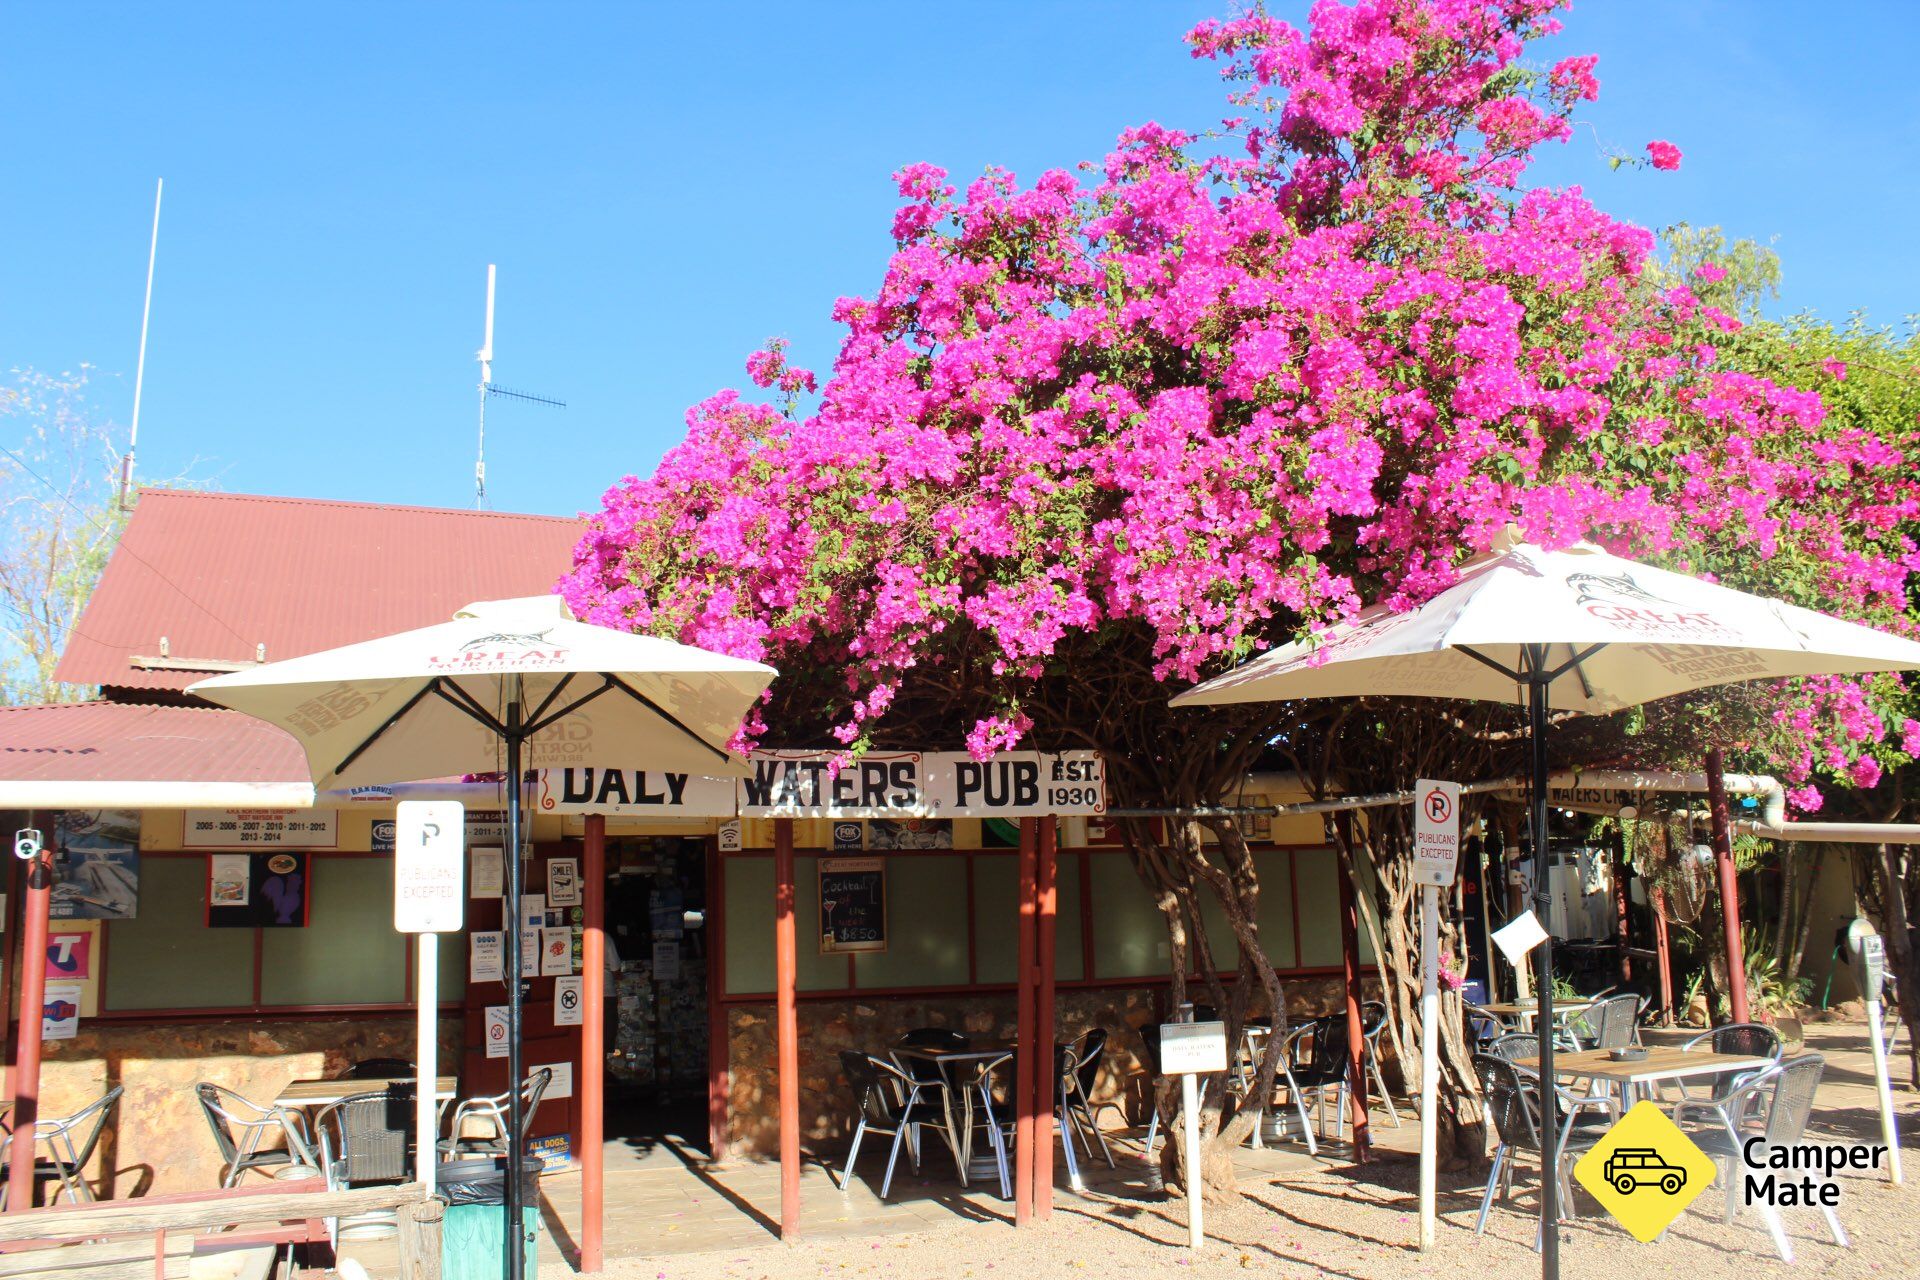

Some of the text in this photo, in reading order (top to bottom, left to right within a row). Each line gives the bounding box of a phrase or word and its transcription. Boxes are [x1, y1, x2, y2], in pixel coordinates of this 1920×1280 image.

[561, 759, 1101, 808] DALY WATERS PUB EST.
[1048, 787, 1098, 806] 1930
[196, 821, 213, 830] 2005
[219, 821, 237, 830] 2006
[242, 822, 260, 831] 2007
[266, 822, 283, 831] 2010
[288, 823, 305, 831] 2011
[310, 823, 326, 831] 2012
[240, 832, 258, 841] 2013
[263, 832, 281, 841] 2014
[473, 828, 491, 836] 2011
[839, 827, 856, 836] FOX
[1418, 832, 1456, 845] PUBLICANS
[1420, 847, 1454, 860] EXCEPTED
[530, 1141, 544, 1150] ALL
